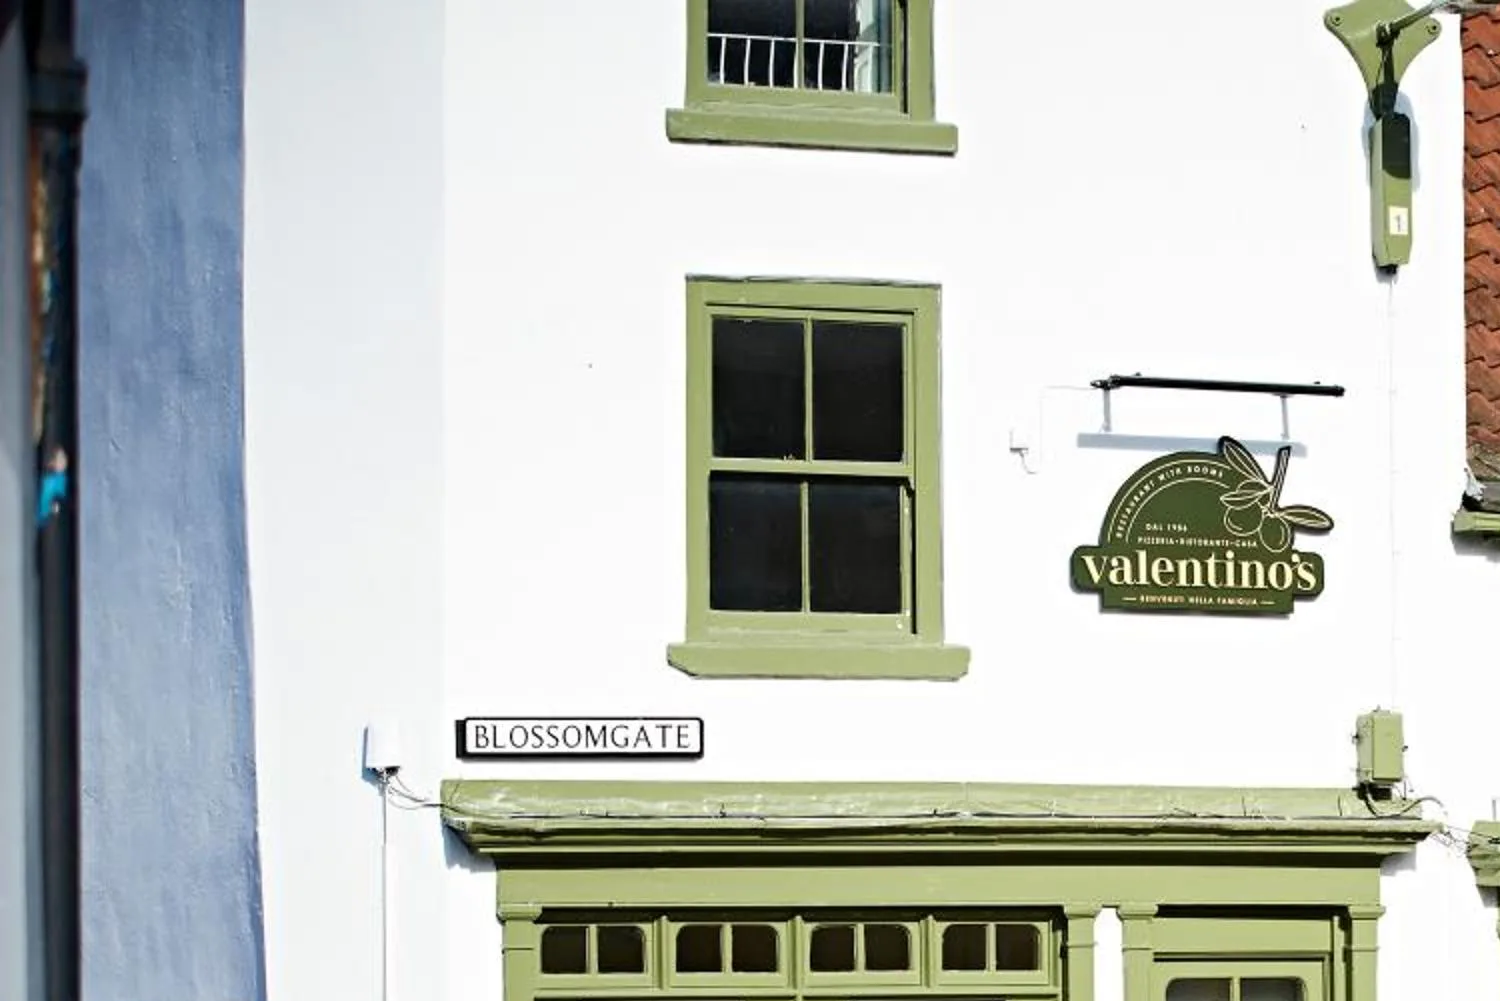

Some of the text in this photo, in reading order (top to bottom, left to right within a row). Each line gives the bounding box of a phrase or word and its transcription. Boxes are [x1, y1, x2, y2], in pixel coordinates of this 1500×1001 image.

[1186, 464, 1224, 479] ROOMS
[1082, 550, 1317, 591] valentino's
[474, 724, 690, 749] BLOSSOMGATE
